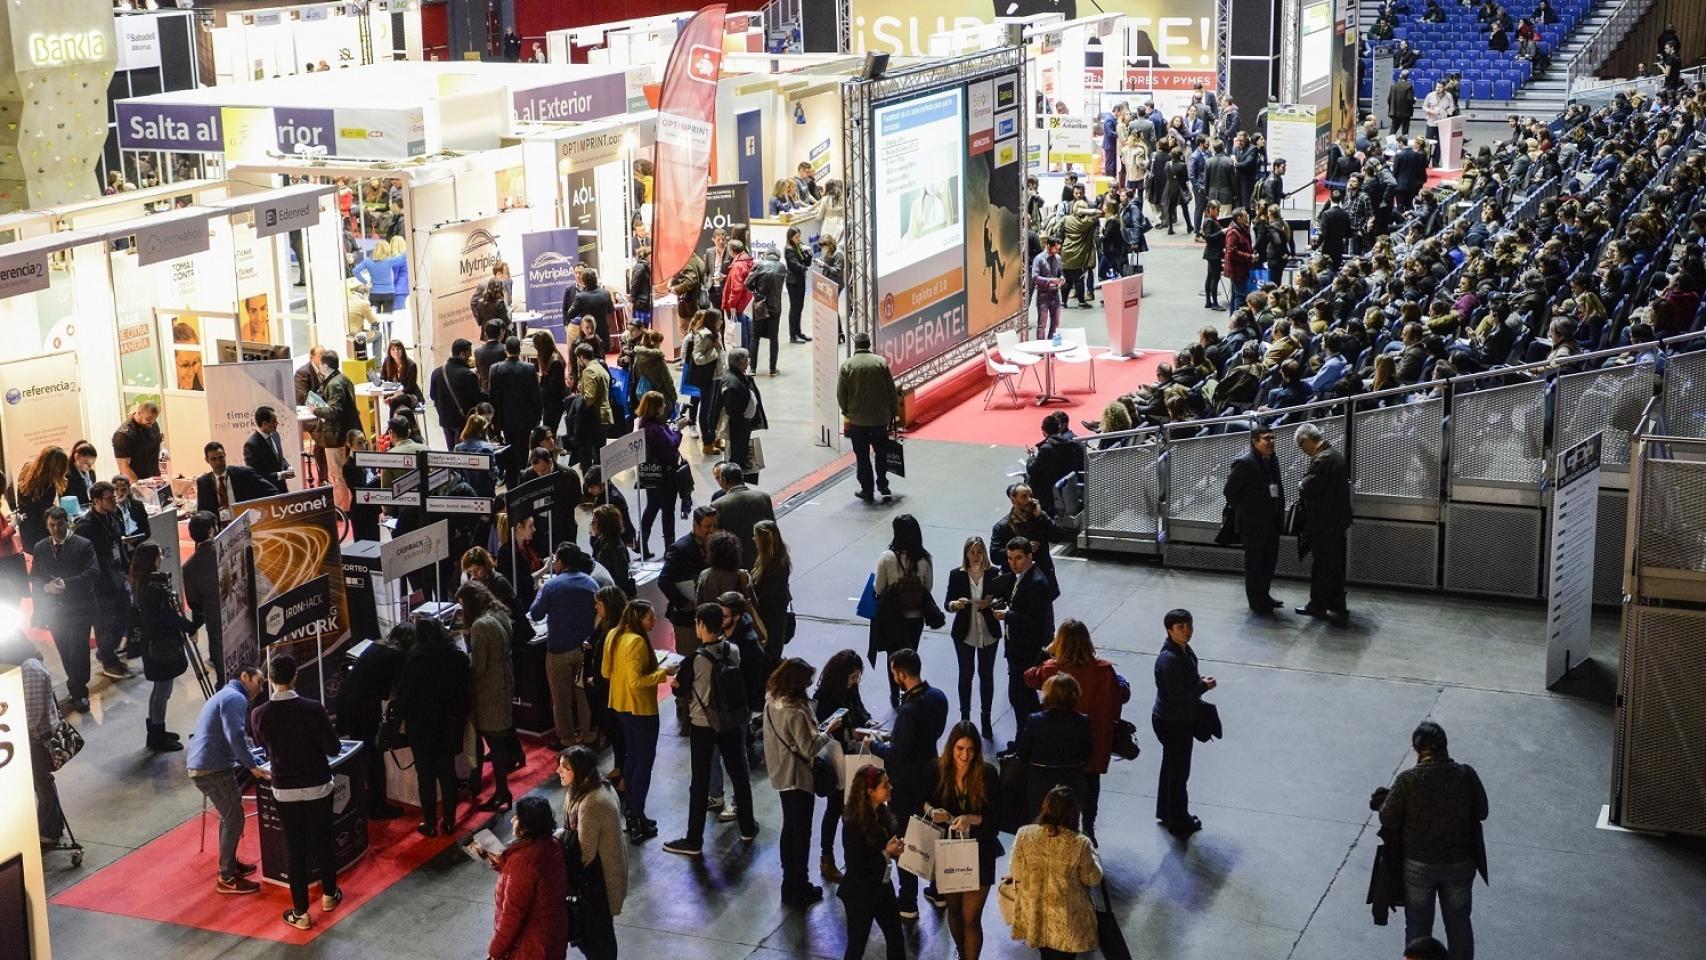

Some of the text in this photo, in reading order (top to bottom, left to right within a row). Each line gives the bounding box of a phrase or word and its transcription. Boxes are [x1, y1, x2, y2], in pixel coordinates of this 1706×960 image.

[33, 32, 106, 63] Bankia
[1162, 76, 1171, 85] Y
[1173, 76, 1211, 85] PYMES
[523, 98, 535, 120] al
[539, 91, 592, 121] Exterior
[130, 114, 218, 141] Salta al
[277, 118, 323, 145] rior
[572, 186, 595, 207] AOL
[278, 204, 310, 221] Edenred
[703, 213, 735, 230] AOL
[751, 239, 777, 250] ebook
[0, 261, 43, 282] erencia2
[459, 250, 501, 277] MytripleA
[529, 266, 576, 283] MytripleA
[121, 338, 149, 354] ANERA
[226, 409, 251, 420] time
[639, 462, 662, 472] Salón
[270, 494, 327, 520] Lyconet
[370, 492, 417, 503] eComerce
[341, 564, 368, 573] SORTEO
[285, 593, 324, 619] IRONHACK
[284, 616, 339, 641] WORK
